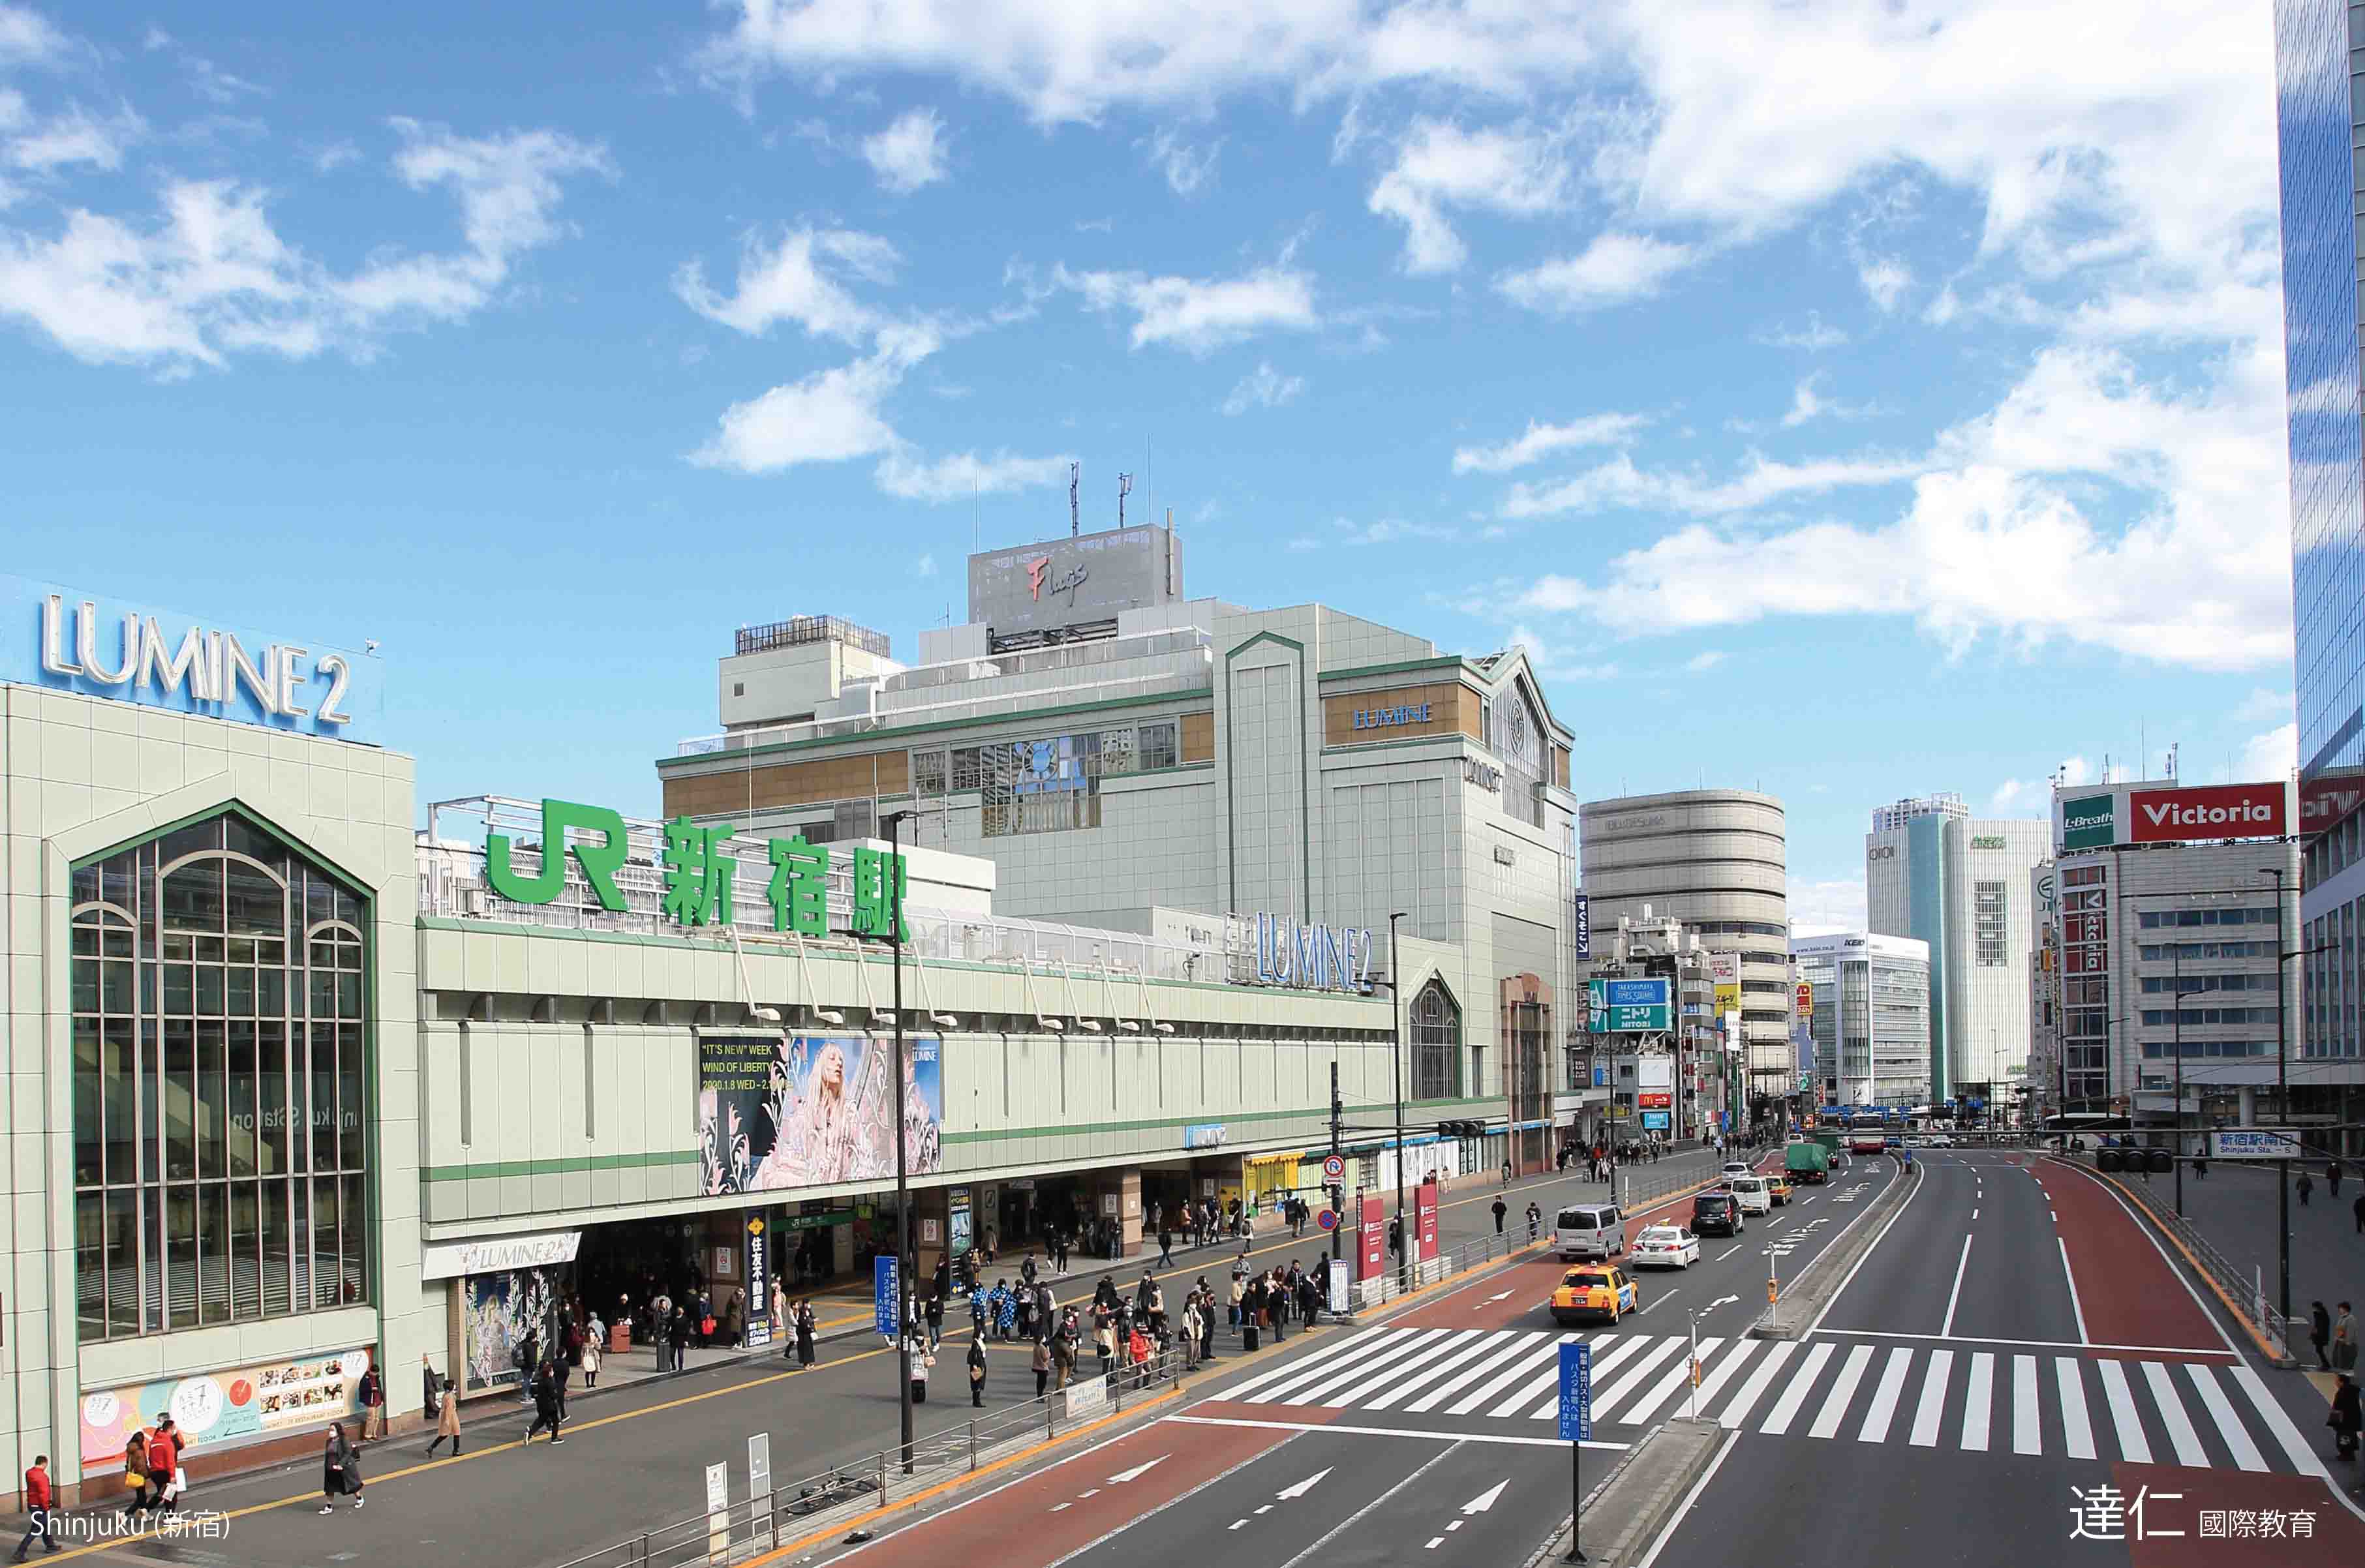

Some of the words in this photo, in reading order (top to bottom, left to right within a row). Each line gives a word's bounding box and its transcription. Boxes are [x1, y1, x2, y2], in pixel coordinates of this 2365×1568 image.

[42, 594, 309, 716] LUMINE
[318, 654, 350, 724] 2
[1353, 702, 1432, 731] LUMINE
[2142, 799, 2271, 826] Victoria
[1257, 911, 1358, 991] LUMINE
[1361, 929, 1373, 991] 2
[1621, 1007, 1651, 1019] ニトリ
[749, 1045, 772, 1055] WEEK
[702, 1062, 725, 1073] WIND
[726, 1062, 738, 1072] OF
[739, 1062, 772, 1072] LIBERTY
[737, 1079, 755, 1090] WED
[2220, 1134, 2293, 1146] 新宿駅南口
[2220, 1146, 2255, 1154] Shinjuku
[480, 1243, 543, 1269] LUMINE
[751, 1237, 763, 1310] 住友不動産
[1570, 1363, 1579, 1421] バスタ新宿へは
[1561, 1395, 1570, 1438] 入れません
